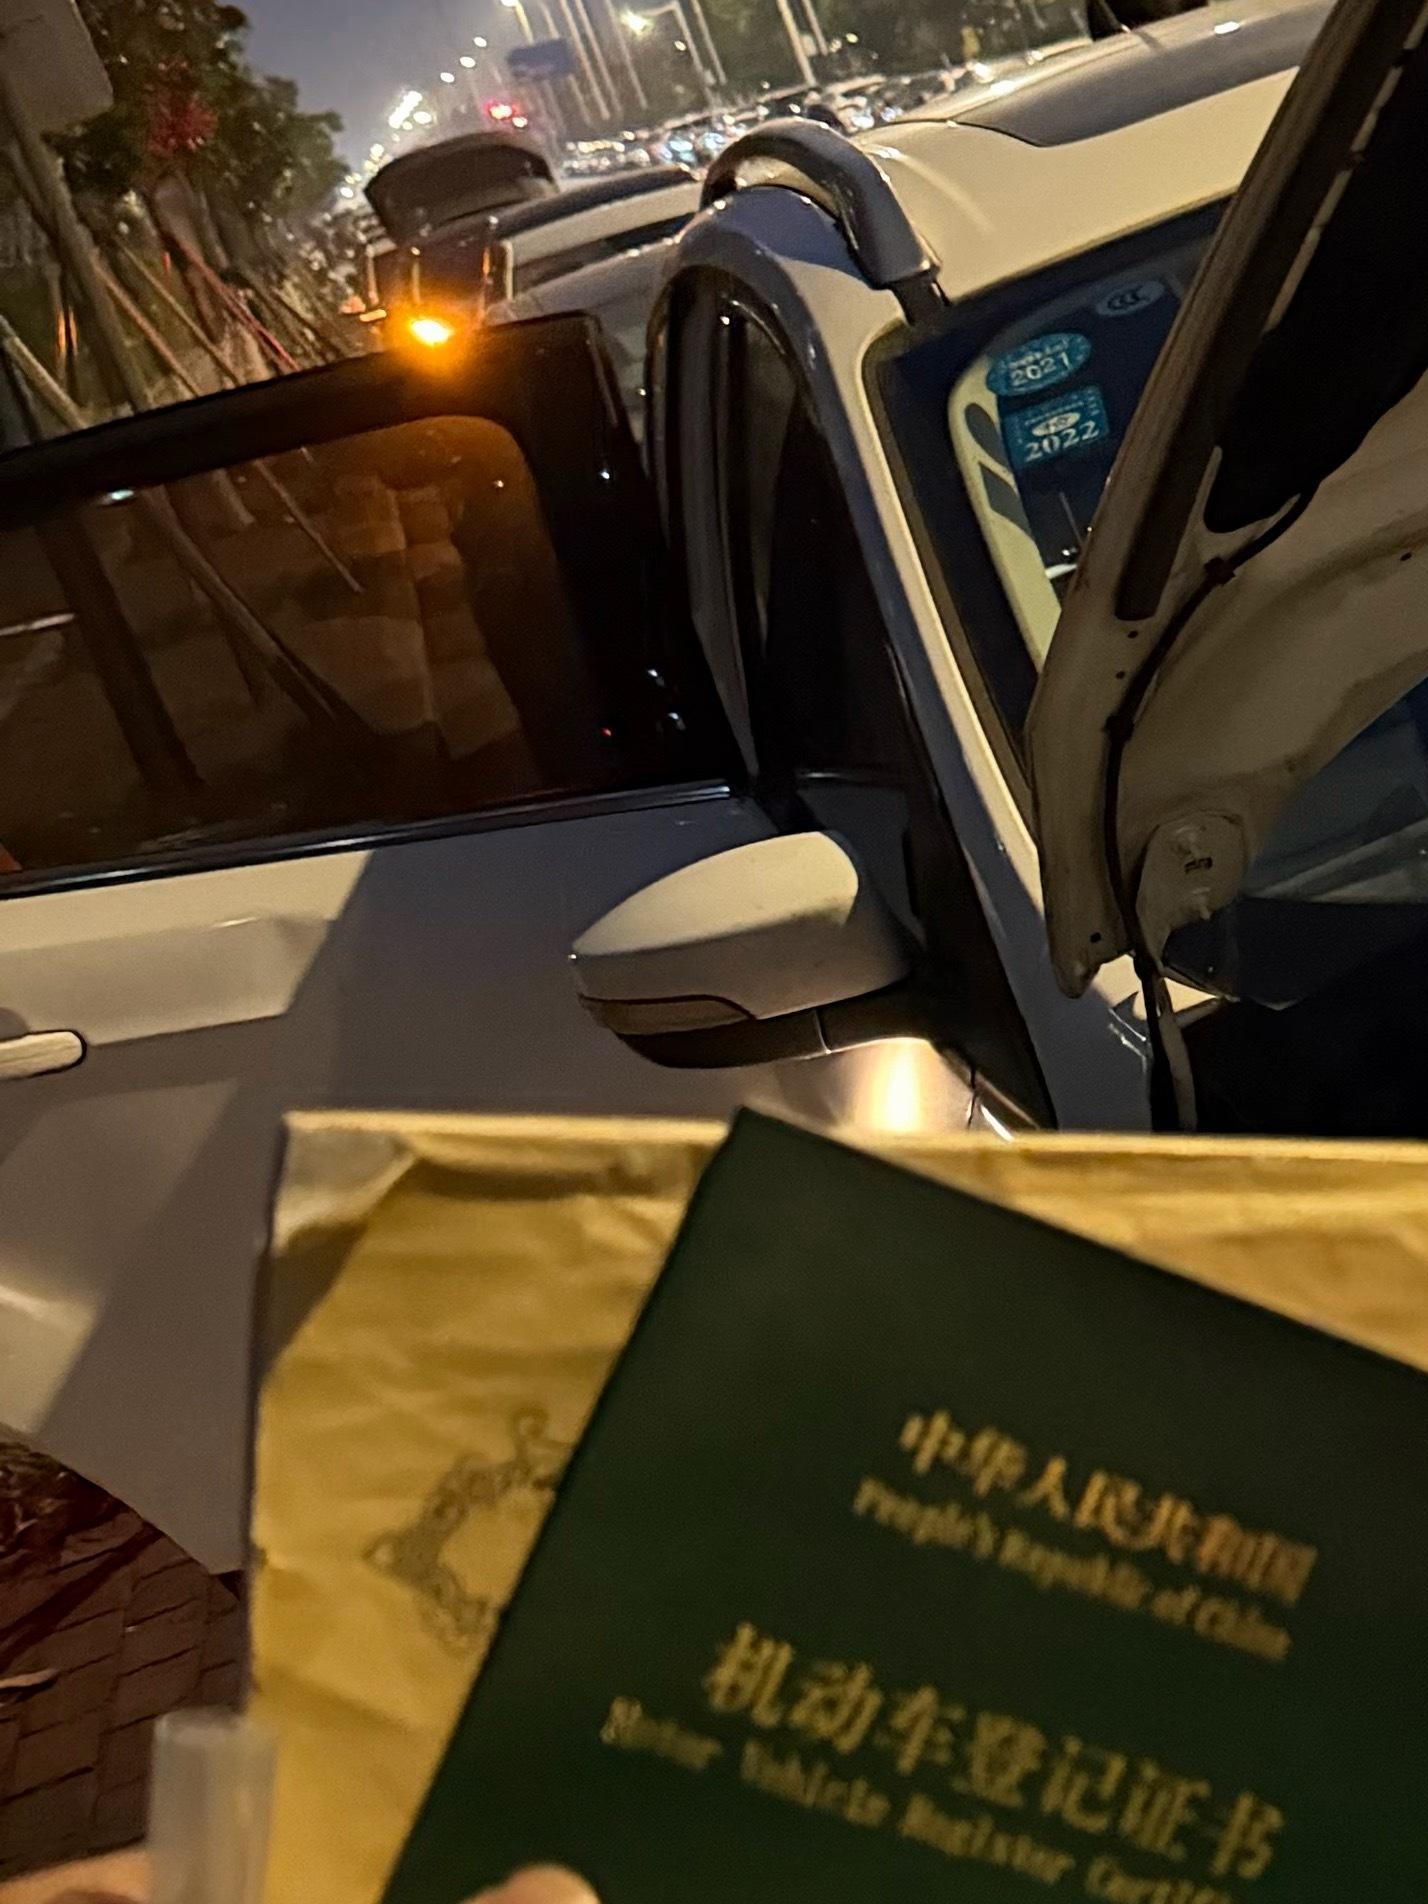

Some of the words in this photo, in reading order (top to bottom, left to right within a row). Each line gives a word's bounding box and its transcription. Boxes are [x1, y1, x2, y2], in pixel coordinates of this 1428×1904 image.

[1011, 352, 1071, 386] 2021
[1025, 420, 1099, 462] 2022
[900, 1409, 1318, 1606] 中华人民共和国
[704, 1621, 1284, 1881] 机动车登记证书
